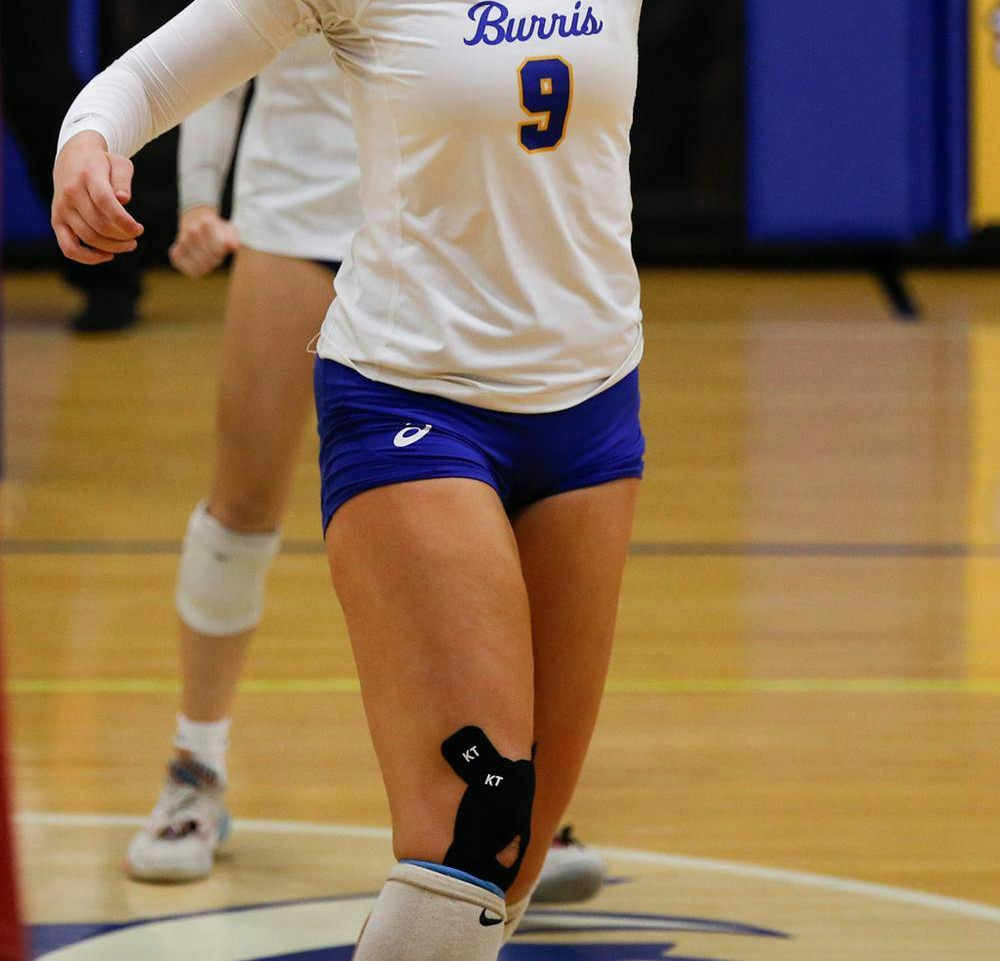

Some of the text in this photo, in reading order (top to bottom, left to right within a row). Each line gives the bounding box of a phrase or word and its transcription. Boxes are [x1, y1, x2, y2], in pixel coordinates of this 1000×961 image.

[463, 0, 603, 46] Burris
[516, 54, 574, 154] 9
[462, 745, 480, 763] KT
[484, 773, 504, 787] KT
